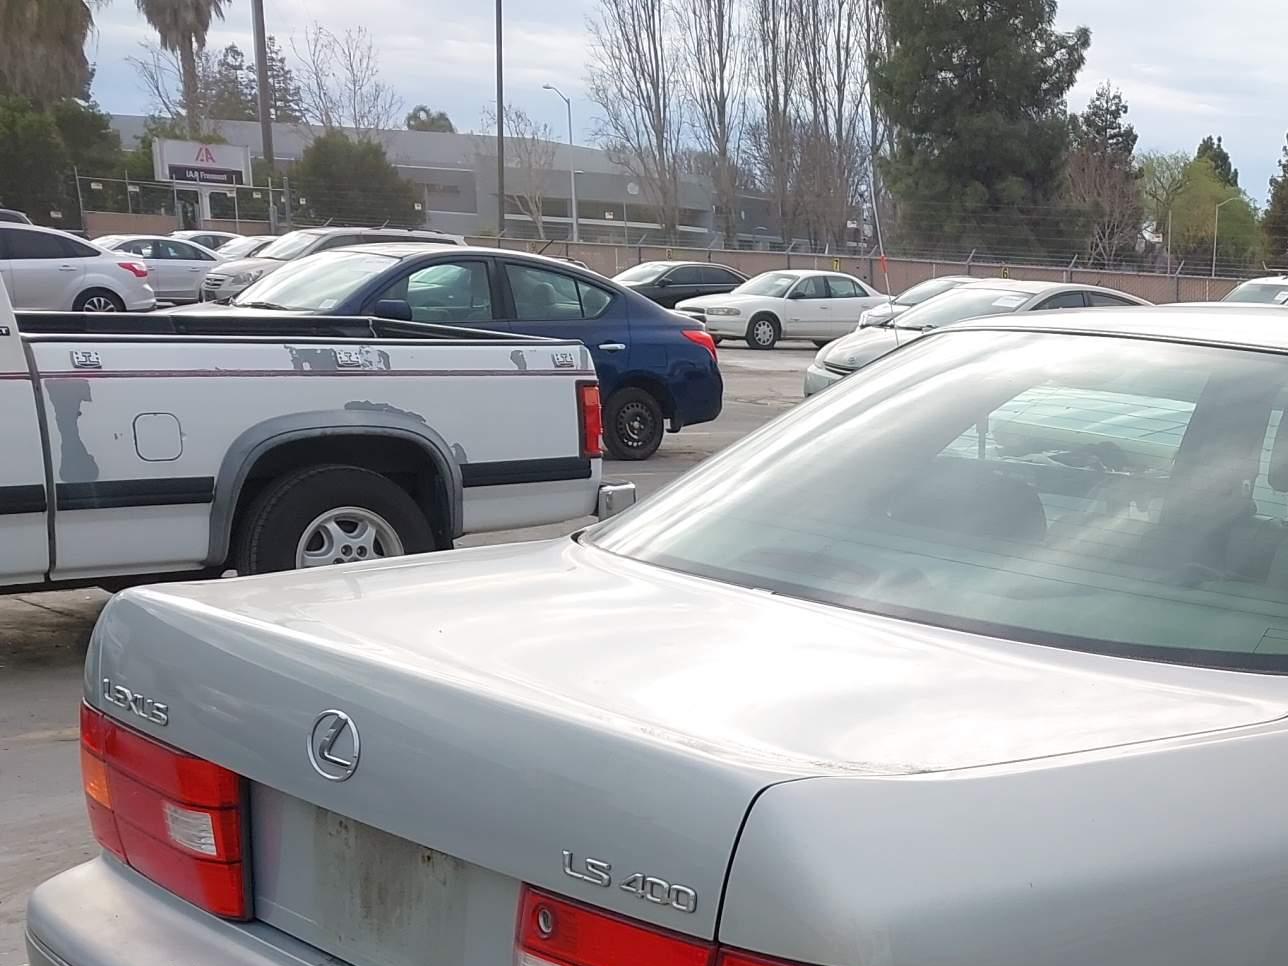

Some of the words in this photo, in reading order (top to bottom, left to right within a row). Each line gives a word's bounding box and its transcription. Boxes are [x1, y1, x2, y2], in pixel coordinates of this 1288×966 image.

[103, 678, 168, 727] LEXUS
[562, 849, 612, 888] LS
[619, 872, 698, 913] 400
